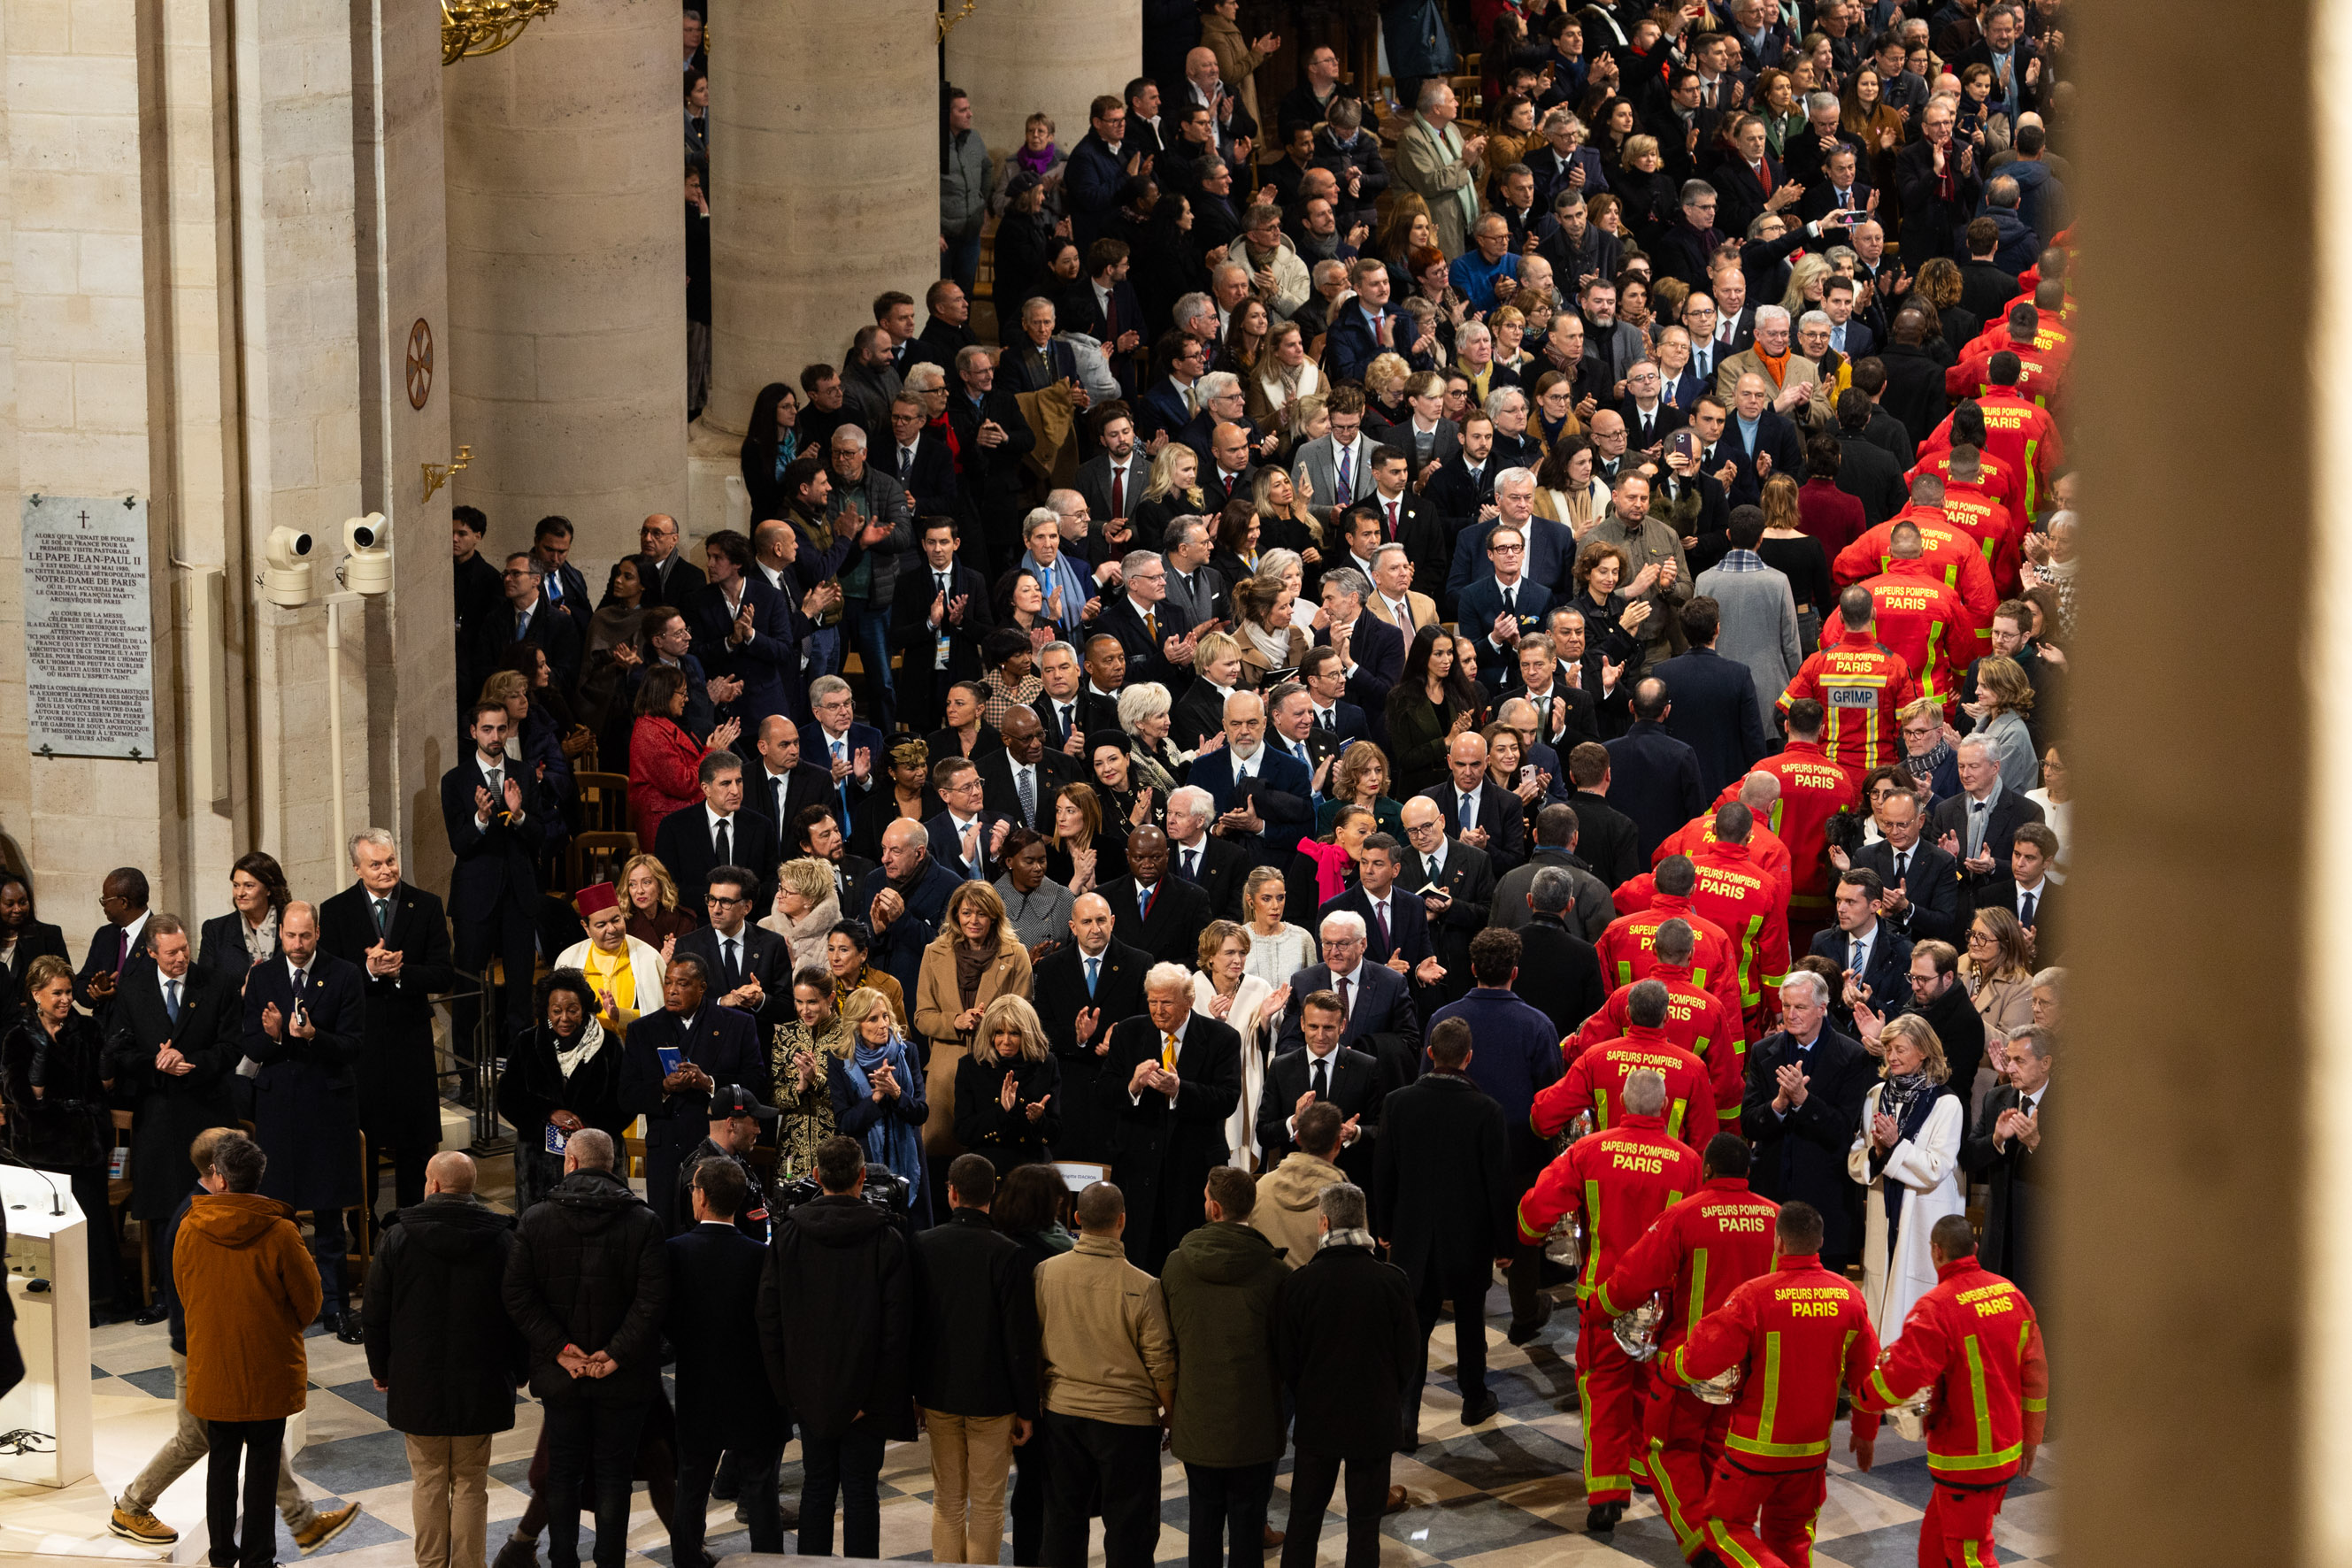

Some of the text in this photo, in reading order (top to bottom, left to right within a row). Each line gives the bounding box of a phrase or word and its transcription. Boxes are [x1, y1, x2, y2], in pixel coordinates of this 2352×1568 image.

[2038, 328, 2066, 343] POMPIERS
[2033, 337, 2053, 350] RIS
[2001, 407, 2032, 419] POMPIERS
[1984, 416, 2021, 429] PARIS
[1959, 502, 1991, 517] POMPIERS
[1920, 528, 1952, 542] POMPIERS
[29, 552, 141, 565] LE PAPE JEAN-PAUL II
[35, 575, 95, 584] NOTRE-DAME
[111, 578, 136, 586] PARIS
[1874, 586, 1938, 599] SAPEURS POMPIERS
[1885, 597, 1926, 610] PARIS
[1826, 653, 1884, 663] SAPEURS POMPIERS
[1836, 661, 1872, 673] PARIS
[1833, 690, 1872, 703] GRIMP
[1781, 764, 1844, 780] SAPEURS POMPIERS
[1795, 774, 1834, 789] PARIS
[1694, 865, 1761, 890] APEURS POMPIERS
[1699, 879, 1745, 900] PARIS
[1629, 925, 1659, 936] SAPEUR
[1667, 1005, 1691, 1021] RIS
[1606, 1050, 1683, 1070] SAPEURS POMPIERS
[1601, 1141, 1680, 1162] SAPEURS POMPIERS
[1613, 1154, 1663, 1174] PARIS
[1701, 1204, 1776, 1218] SAPEURS POMPIERS
[1719, 1218, 1765, 1232] PARIS
[1775, 1287, 1849, 1301] SAPEURS POMPIERS
[1956, 1287, 1989, 1305] SAPEURS
[1791, 1301, 1839, 1317] PARIS
[1974, 1296, 2014, 1318] PARIS
